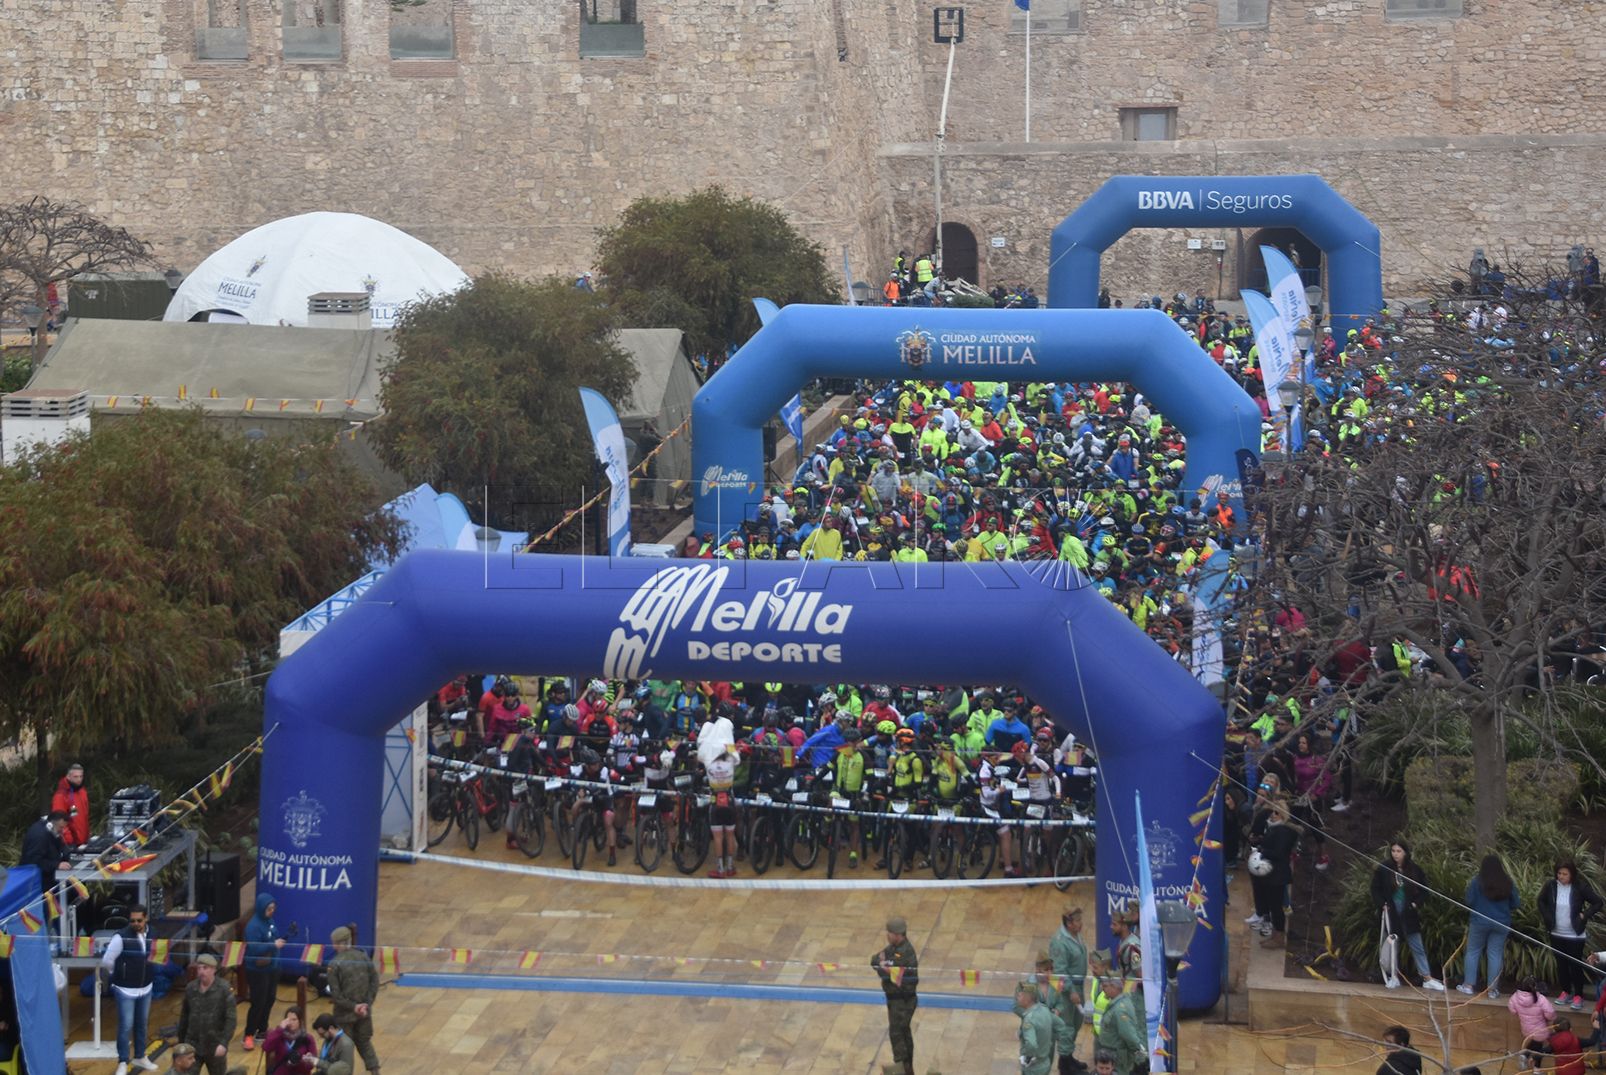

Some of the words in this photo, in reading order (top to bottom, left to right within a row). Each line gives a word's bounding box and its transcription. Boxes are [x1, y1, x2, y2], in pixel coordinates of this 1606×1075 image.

[1137, 190, 1195, 210] BBVA
[1205, 190, 1293, 214] Seguros
[217, 281, 257, 299] MELILLA
[370, 308, 402, 320] ILLA
[940, 333, 977, 344] CIUDAD
[978, 332, 1036, 344] AUTÓNOMA
[942, 345, 1037, 365] MELILLA
[611, 563, 853, 659] Melilla
[687, 640, 842, 663] DEPORTE
[260, 846, 287, 861] CIUDAD
[288, 853, 353, 866] AUTÓNOMA
[260, 858, 353, 890] MELILLA
[1152, 884, 1207, 897] UTÓNOA
